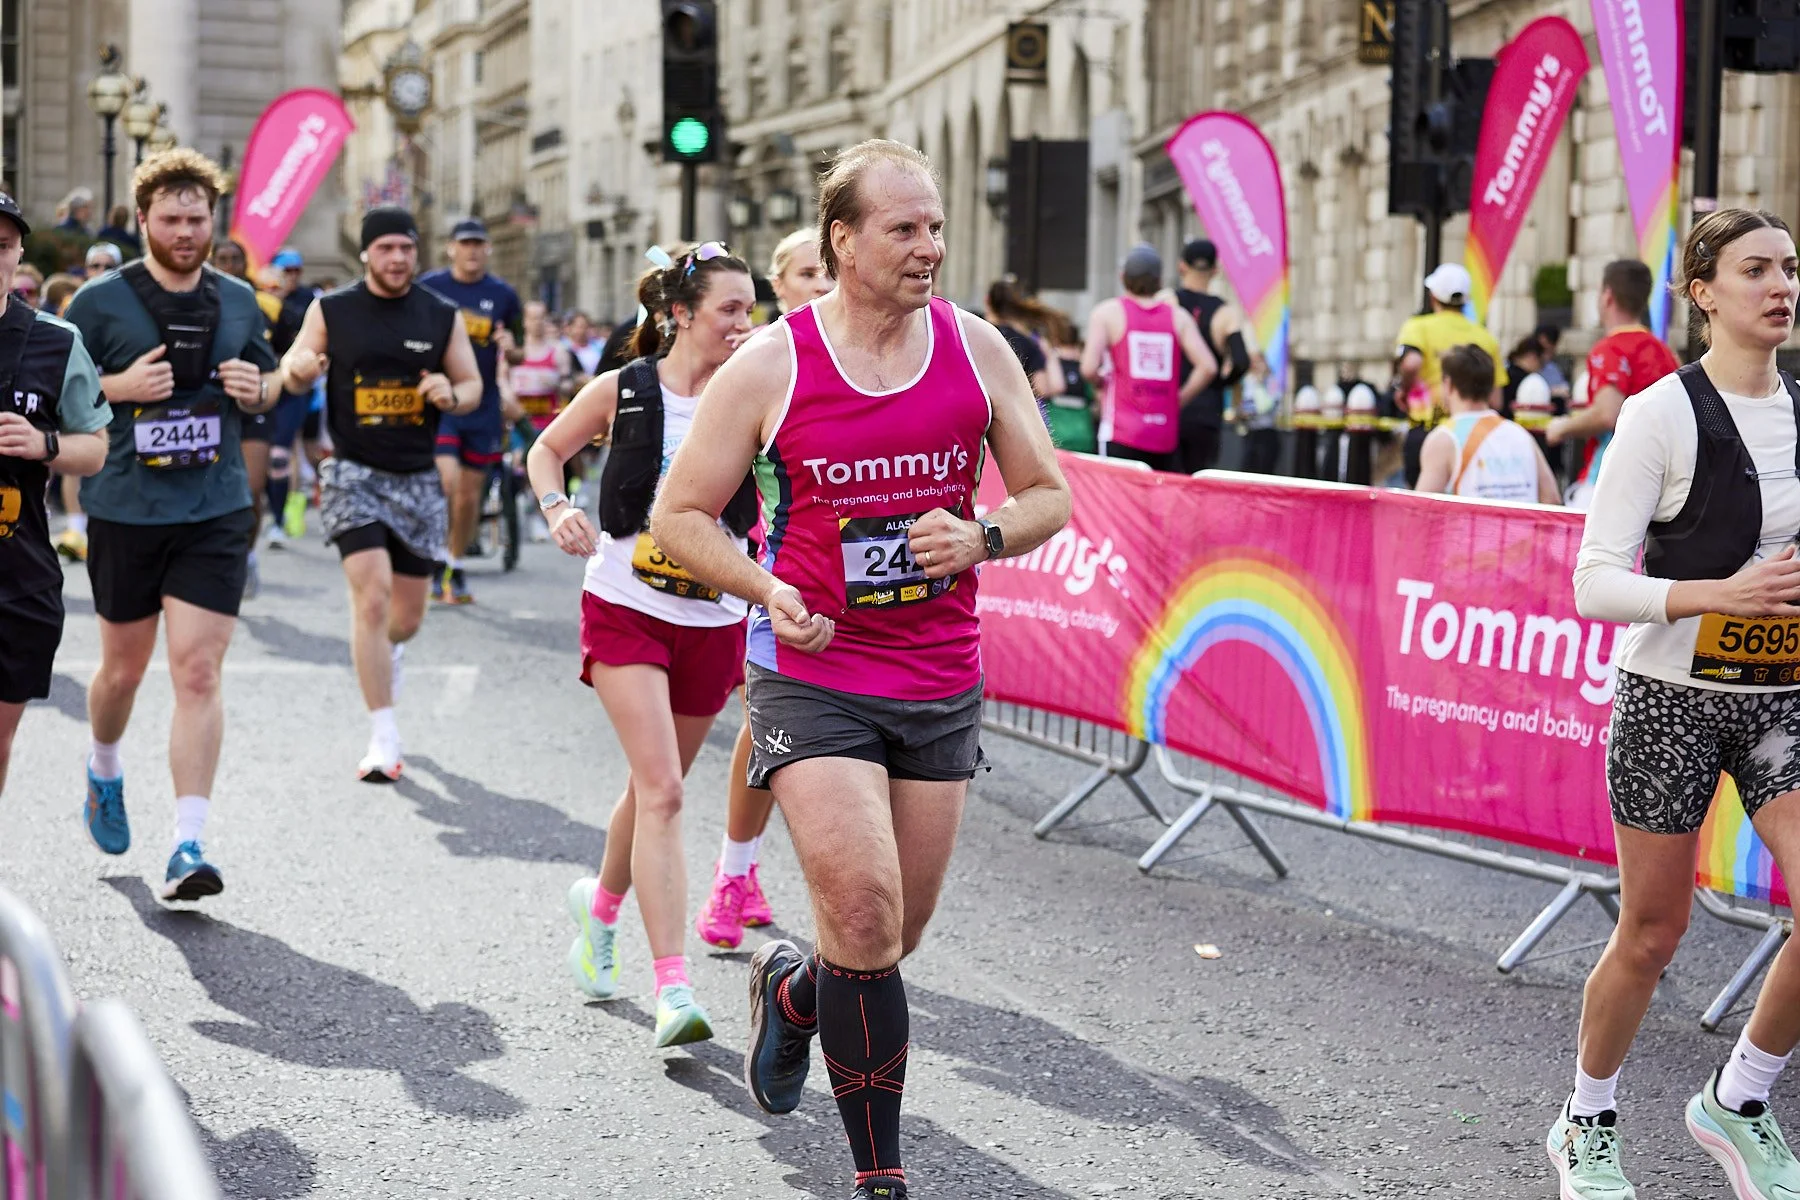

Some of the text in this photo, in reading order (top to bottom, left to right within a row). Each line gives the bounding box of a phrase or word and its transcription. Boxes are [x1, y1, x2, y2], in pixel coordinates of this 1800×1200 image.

[1483, 52, 1560, 206] Tommy's
[367, 394, 415, 411] 3469
[151, 422, 209, 447] 2444
[803, 444, 968, 485] Tommy's
[832, 494, 889, 509] pregnancy
[892, 489, 913, 500] and
[916, 480, 943, 497] baby
[885, 519, 917, 537] ALAST
[864, 543, 925, 577] 24
[1397, 578, 1629, 705] Tommy
[1719, 621, 1799, 655] 5695
[1386, 685, 1410, 712] The
[1412, 694, 1500, 732] pregnancy
[1503, 708, 1540, 733] and
[1543, 710, 1594, 747] baby
